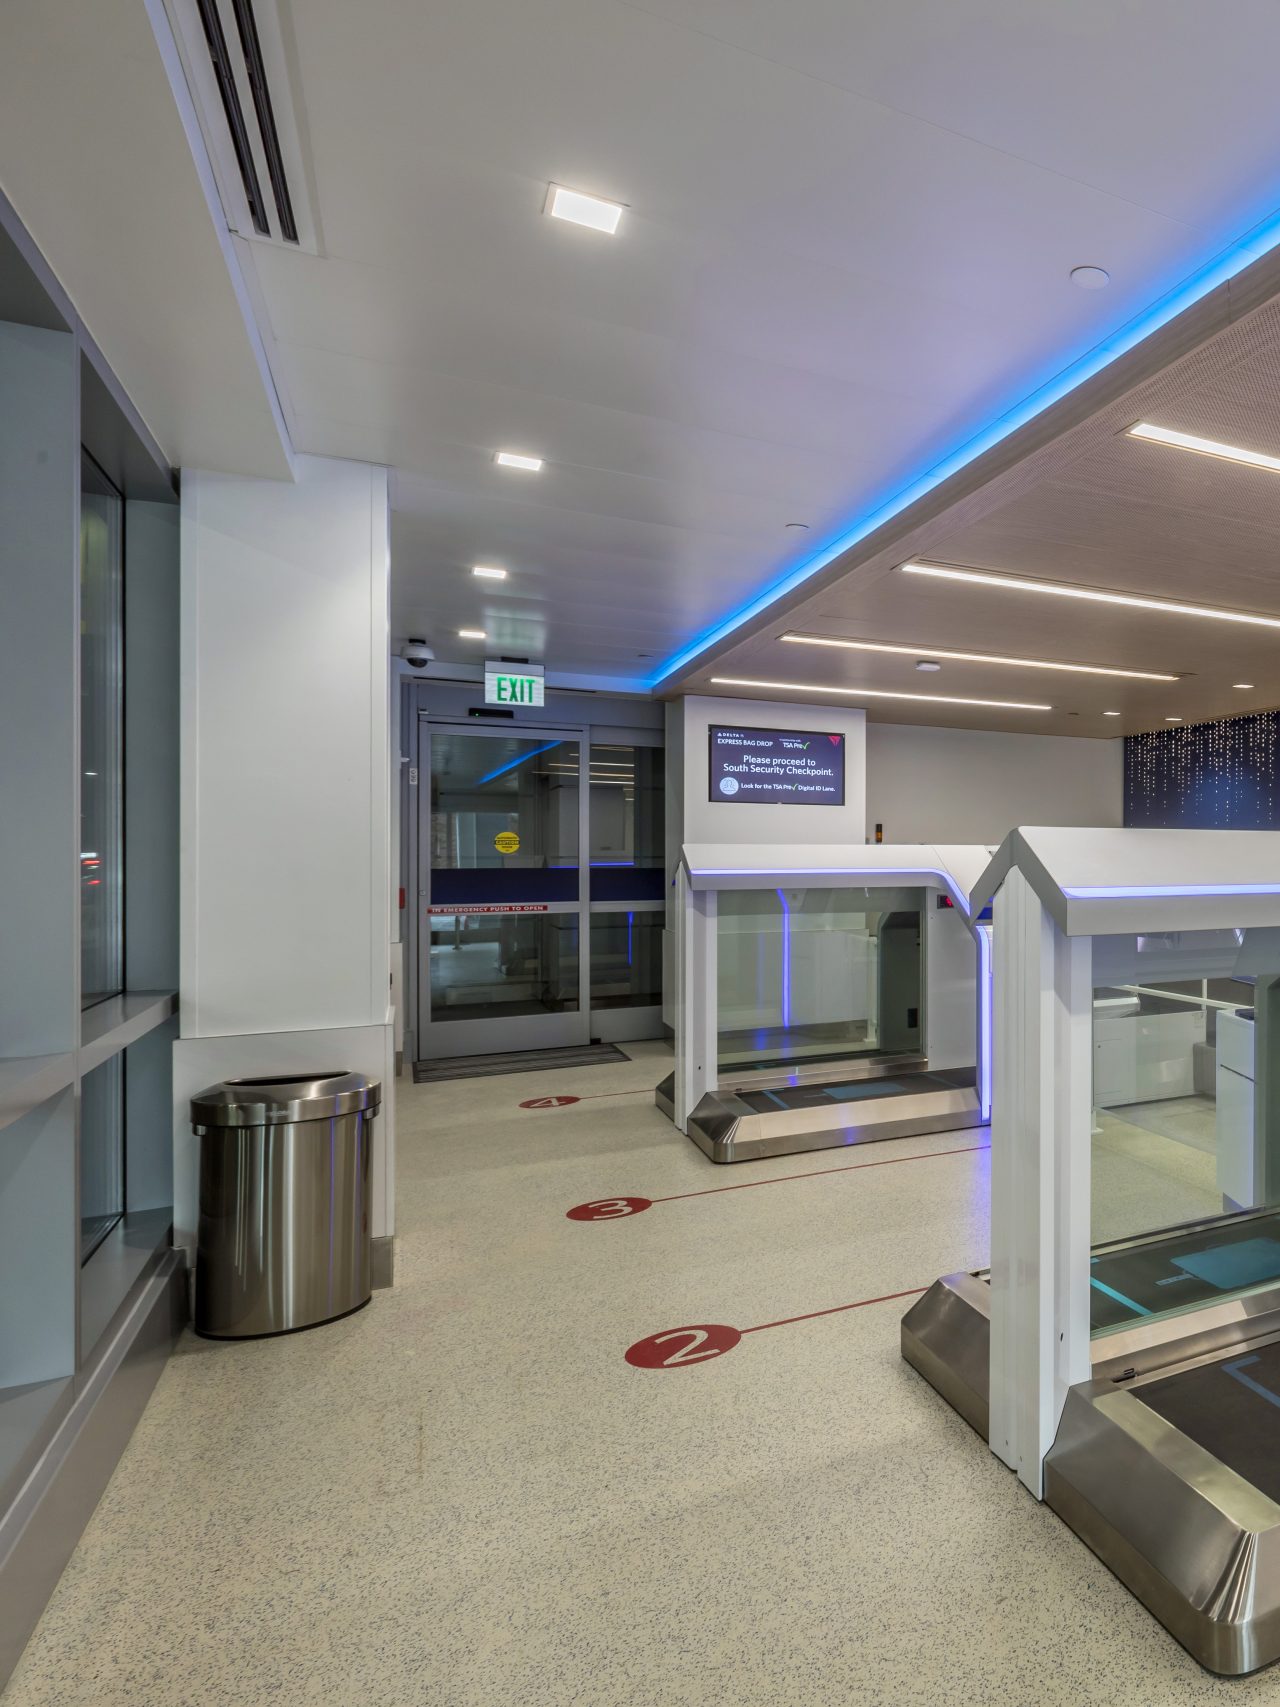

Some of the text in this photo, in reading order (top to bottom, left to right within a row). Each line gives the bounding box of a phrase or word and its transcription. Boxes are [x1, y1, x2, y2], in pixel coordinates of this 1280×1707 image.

[497, 676, 536, 704] EXIT
[743, 755, 771, 764] Please
[772, 758, 806, 766] proceed
[723, 763, 834, 777] South Security Checkpoint.
[798, 784, 815, 792] Digital
[530, 1097, 565, 1107] 4
[589, 1199, 633, 1220] 3
[654, 1329, 721, 1366] 2
